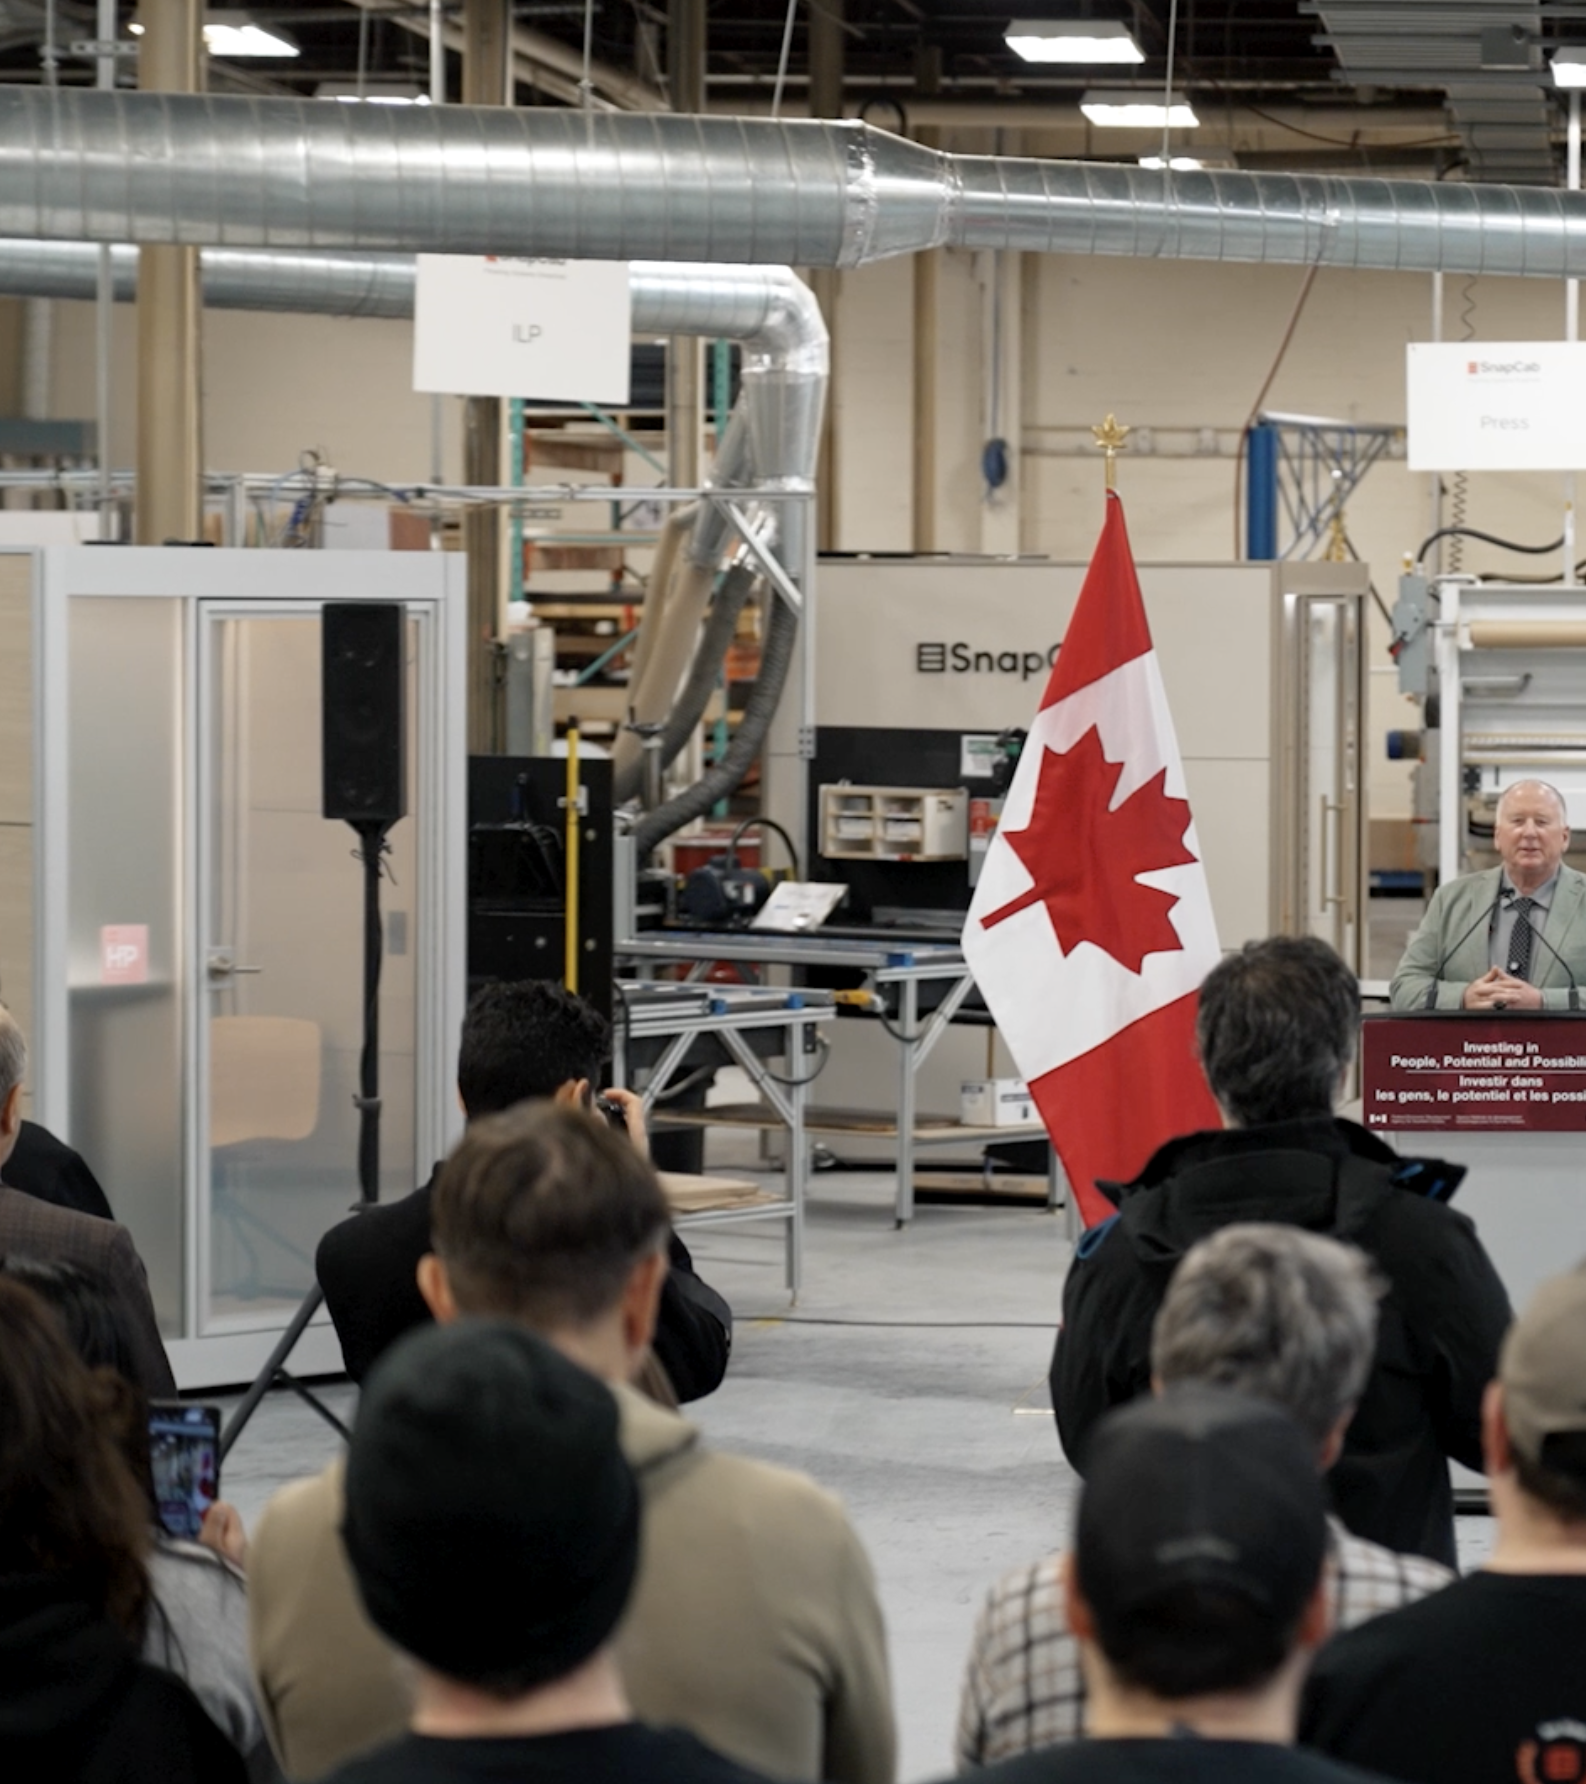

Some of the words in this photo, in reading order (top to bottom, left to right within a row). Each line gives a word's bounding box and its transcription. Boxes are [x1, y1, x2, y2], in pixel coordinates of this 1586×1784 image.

[1480, 361, 1541, 374] SnapCab
[1480, 416, 1530, 430] Press
[1464, 1041, 1524, 1055] Investing
[1527, 1041, 1539, 1053] in
[1391, 1055, 1440, 1069] People,
[1444, 1055, 1502, 1067] Potential
[1505, 1056, 1530, 1068] and
[1459, 1075, 1508, 1087] Investir
[1511, 1075, 1543, 1087] dans
[1376, 1089, 1396, 1101] les
[1398, 1090, 1435, 1104] gens,
[1437, 1089, 1450, 1101] le
[1452, 1089, 1510, 1104] potentiel
[1513, 1090, 1527, 1101] et
[1530, 1089, 1549, 1101] les
